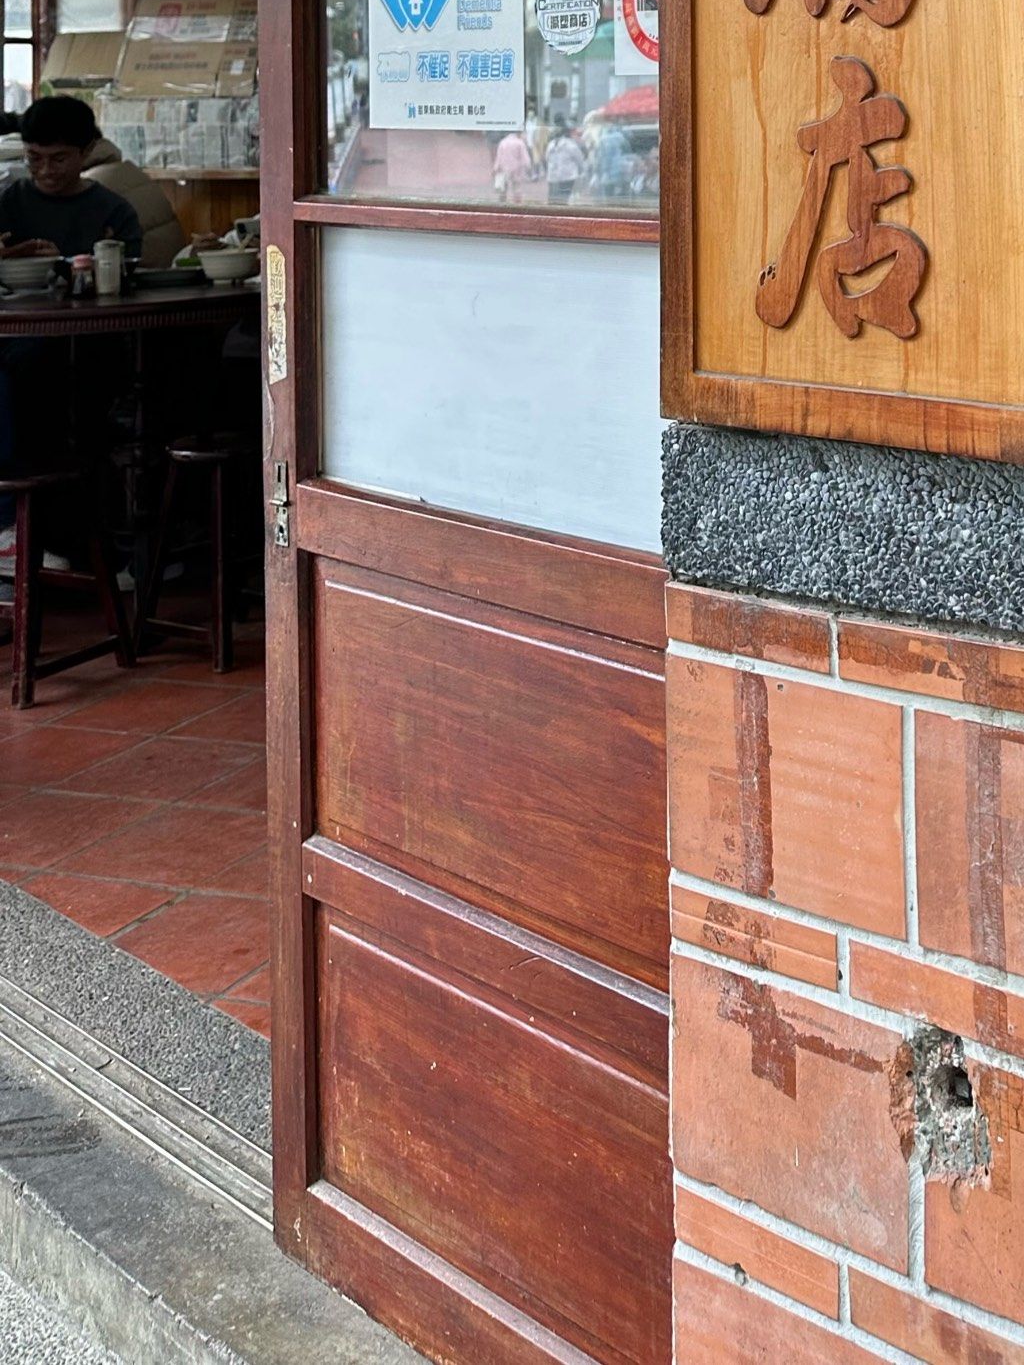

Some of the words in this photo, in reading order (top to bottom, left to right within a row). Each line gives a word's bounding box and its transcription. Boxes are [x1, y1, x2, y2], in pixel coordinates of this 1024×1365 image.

[458, 50, 514, 80] 不傷害自尊
